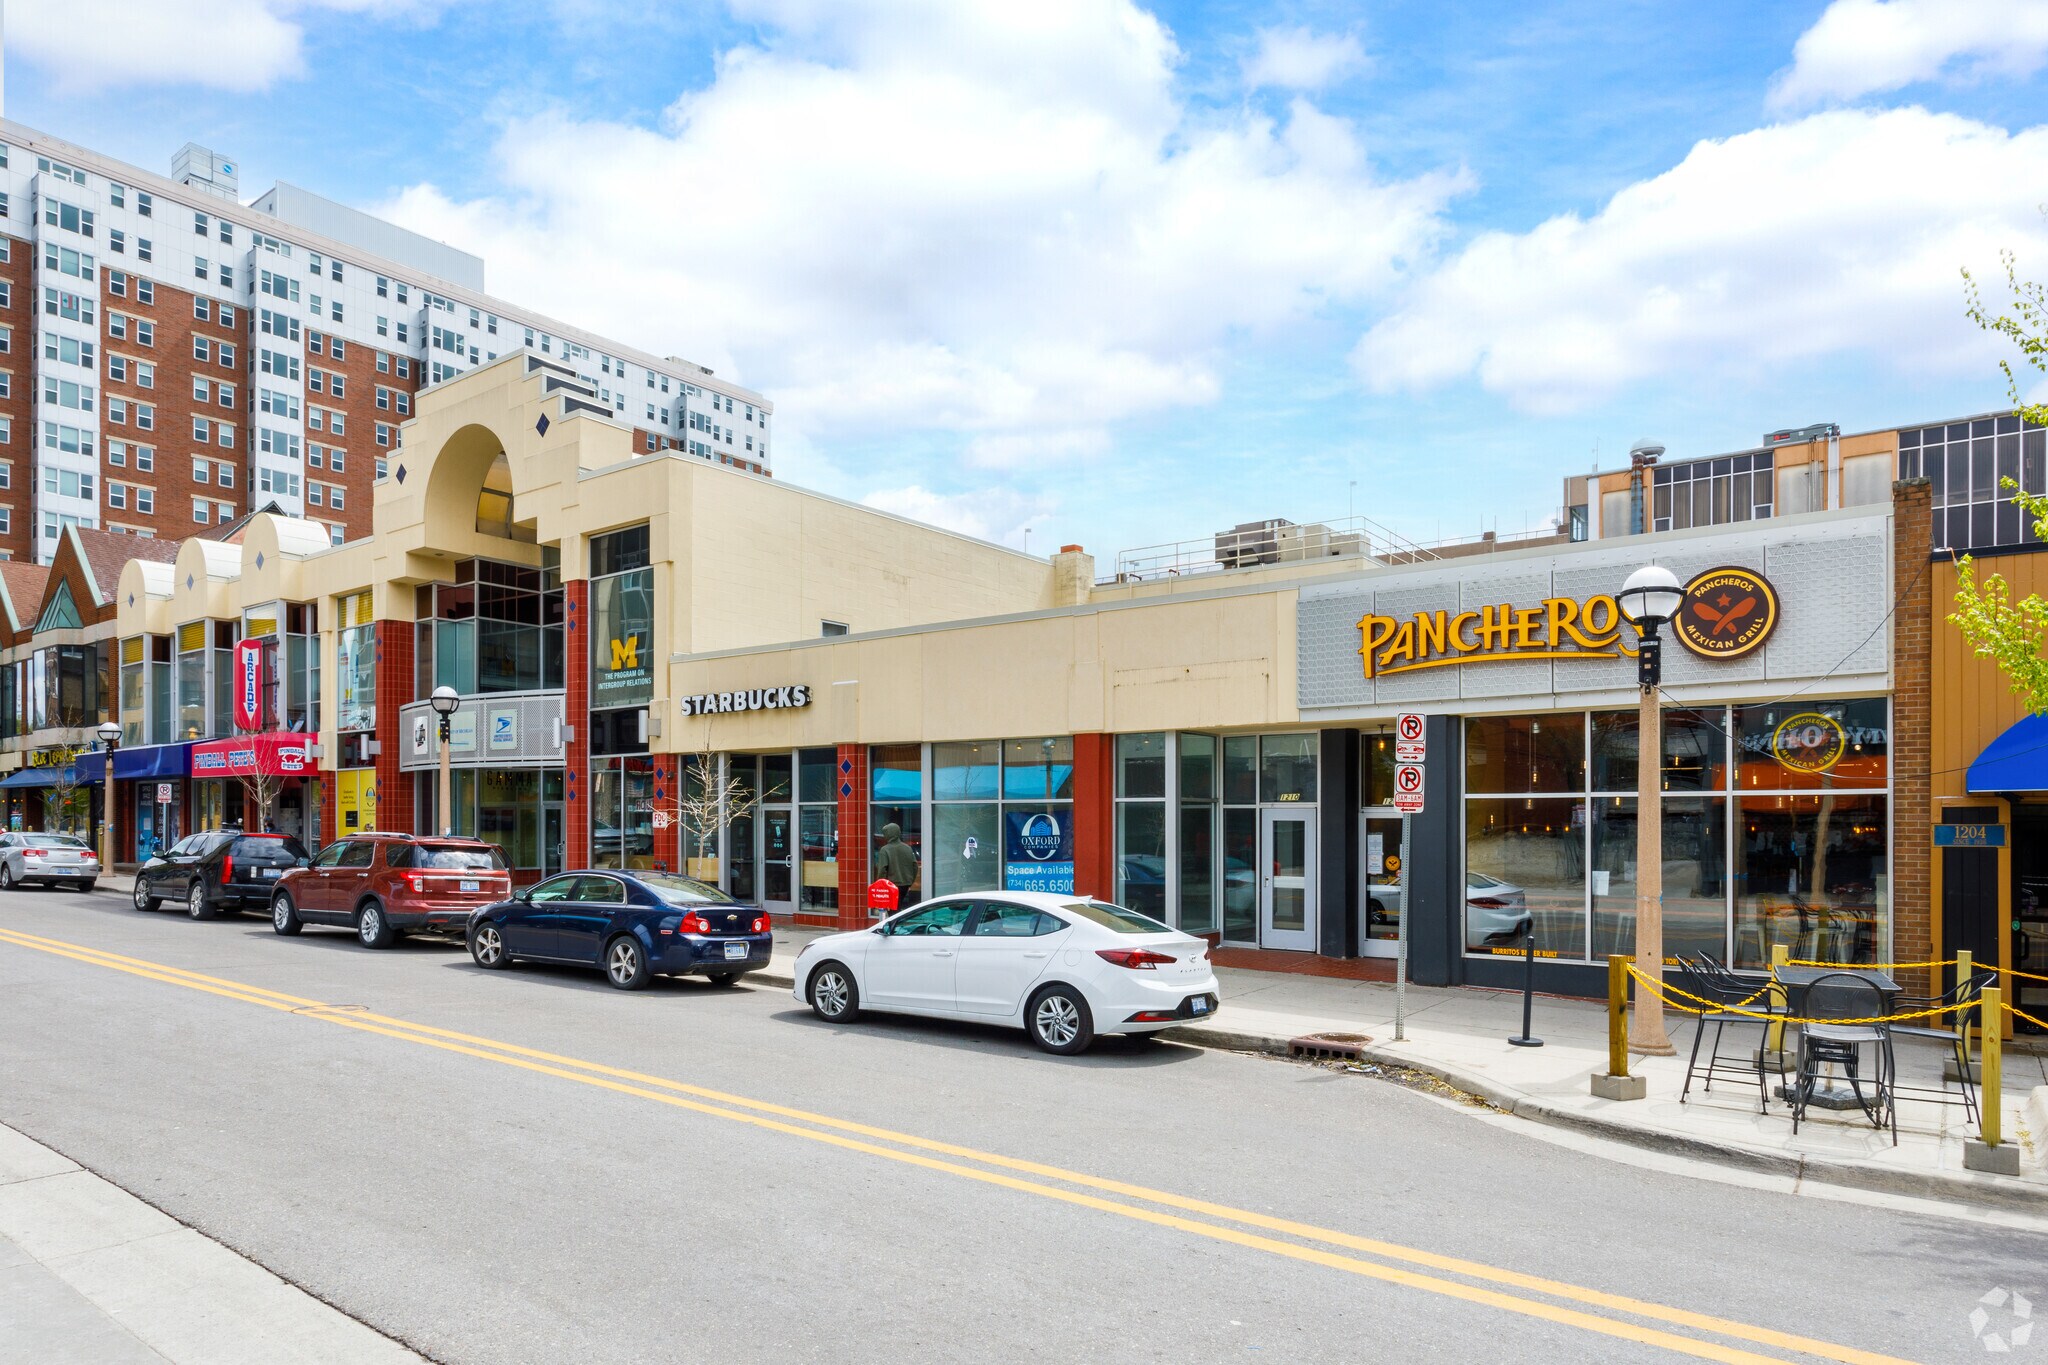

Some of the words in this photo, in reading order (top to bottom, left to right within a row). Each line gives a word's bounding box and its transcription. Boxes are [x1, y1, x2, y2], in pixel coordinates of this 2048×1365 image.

[1694, 578, 1754, 597] PANCHEROS
[1686, 625, 1734, 649] MEXICAN
[1738, 617, 1764, 643] GRILL
[611, 636, 638, 670] M
[605, 672, 613, 680] THE
[614, 670, 637, 679] PROGRAM
[598, 680, 626, 690] INTERGROUP
[626, 677, 652, 686] RELATIONS
[681, 685, 807, 716] STARBUCKS
[1786, 718, 1829, 731] PANCHEROS
[279, 748, 305, 756] PINBALL
[1781, 749, 1815, 767] MEXICAN
[1818, 747, 1837, 764] GRILL
[194, 752, 226, 769] PINBALL
[228, 750, 255, 767] PETE'S
[654, 814, 666, 822] FDC
[1955, 826, 1986, 838] 1204
[1021, 836, 1060, 846] OXFORD
[1007, 866, 1035, 875] Space
[1492, 948, 1520, 956] BURRITOS
[1542, 950, 1558, 958] BUILT
